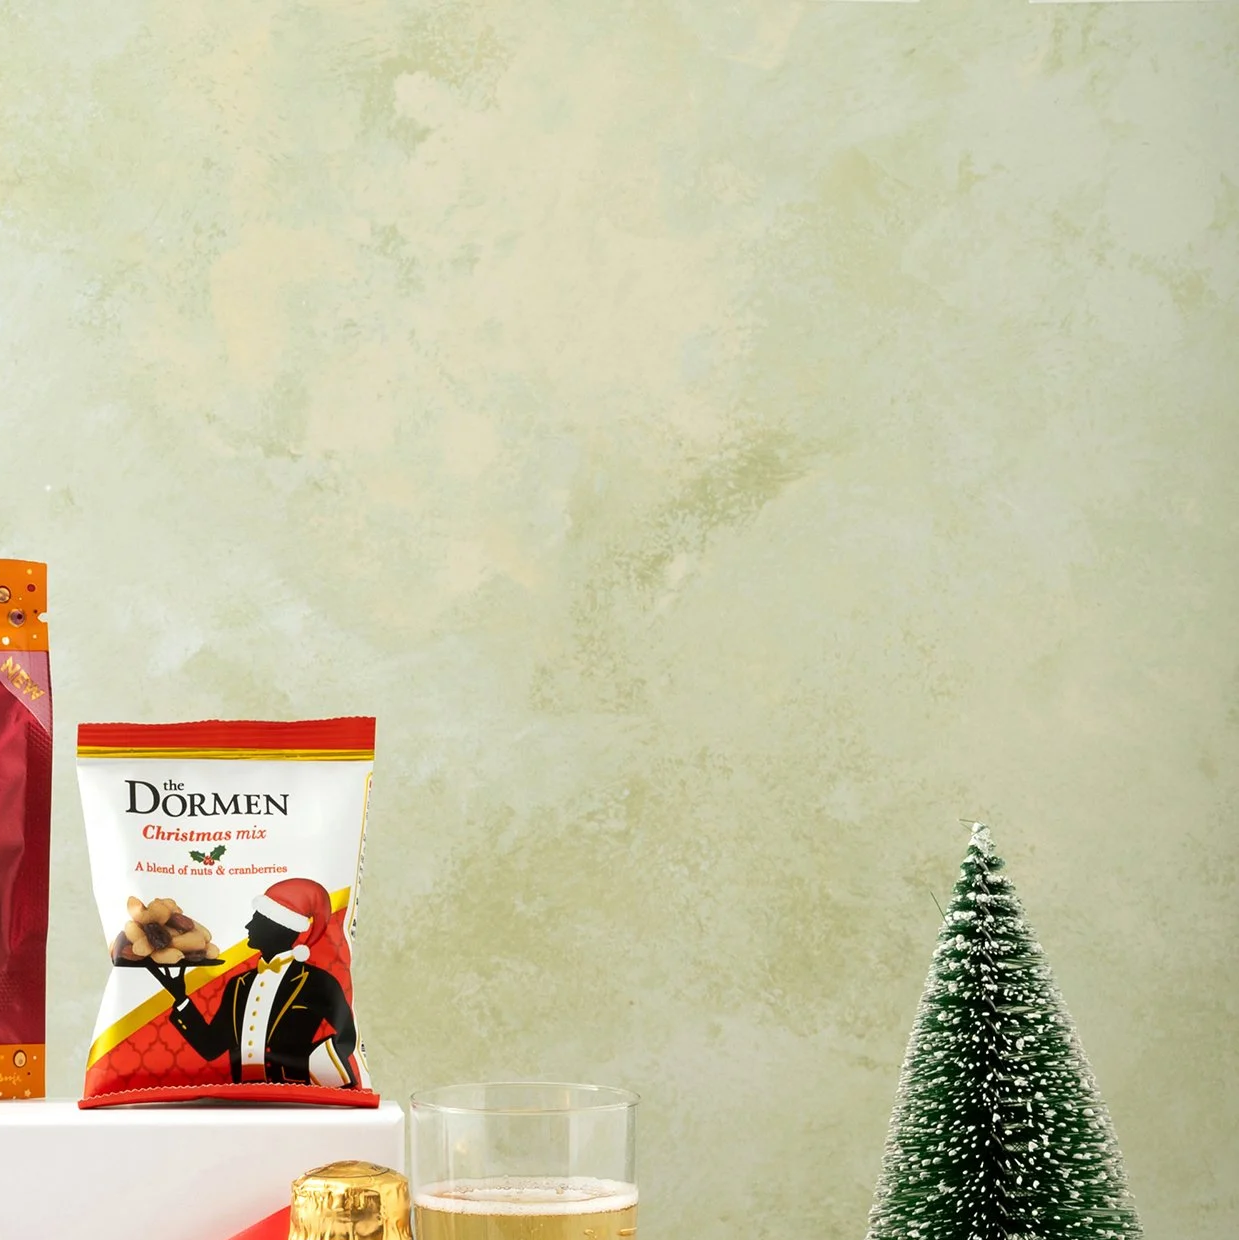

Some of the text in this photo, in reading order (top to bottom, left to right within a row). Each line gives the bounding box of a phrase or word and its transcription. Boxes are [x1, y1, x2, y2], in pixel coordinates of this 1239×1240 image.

[0, 656, 45, 700] NEW
[163, 779, 185, 791] the
[125, 780, 289, 817] DORMEN
[142, 824, 267, 842] Christmas mix
[135, 861, 288, 876] A blend of nuts & cranberries
